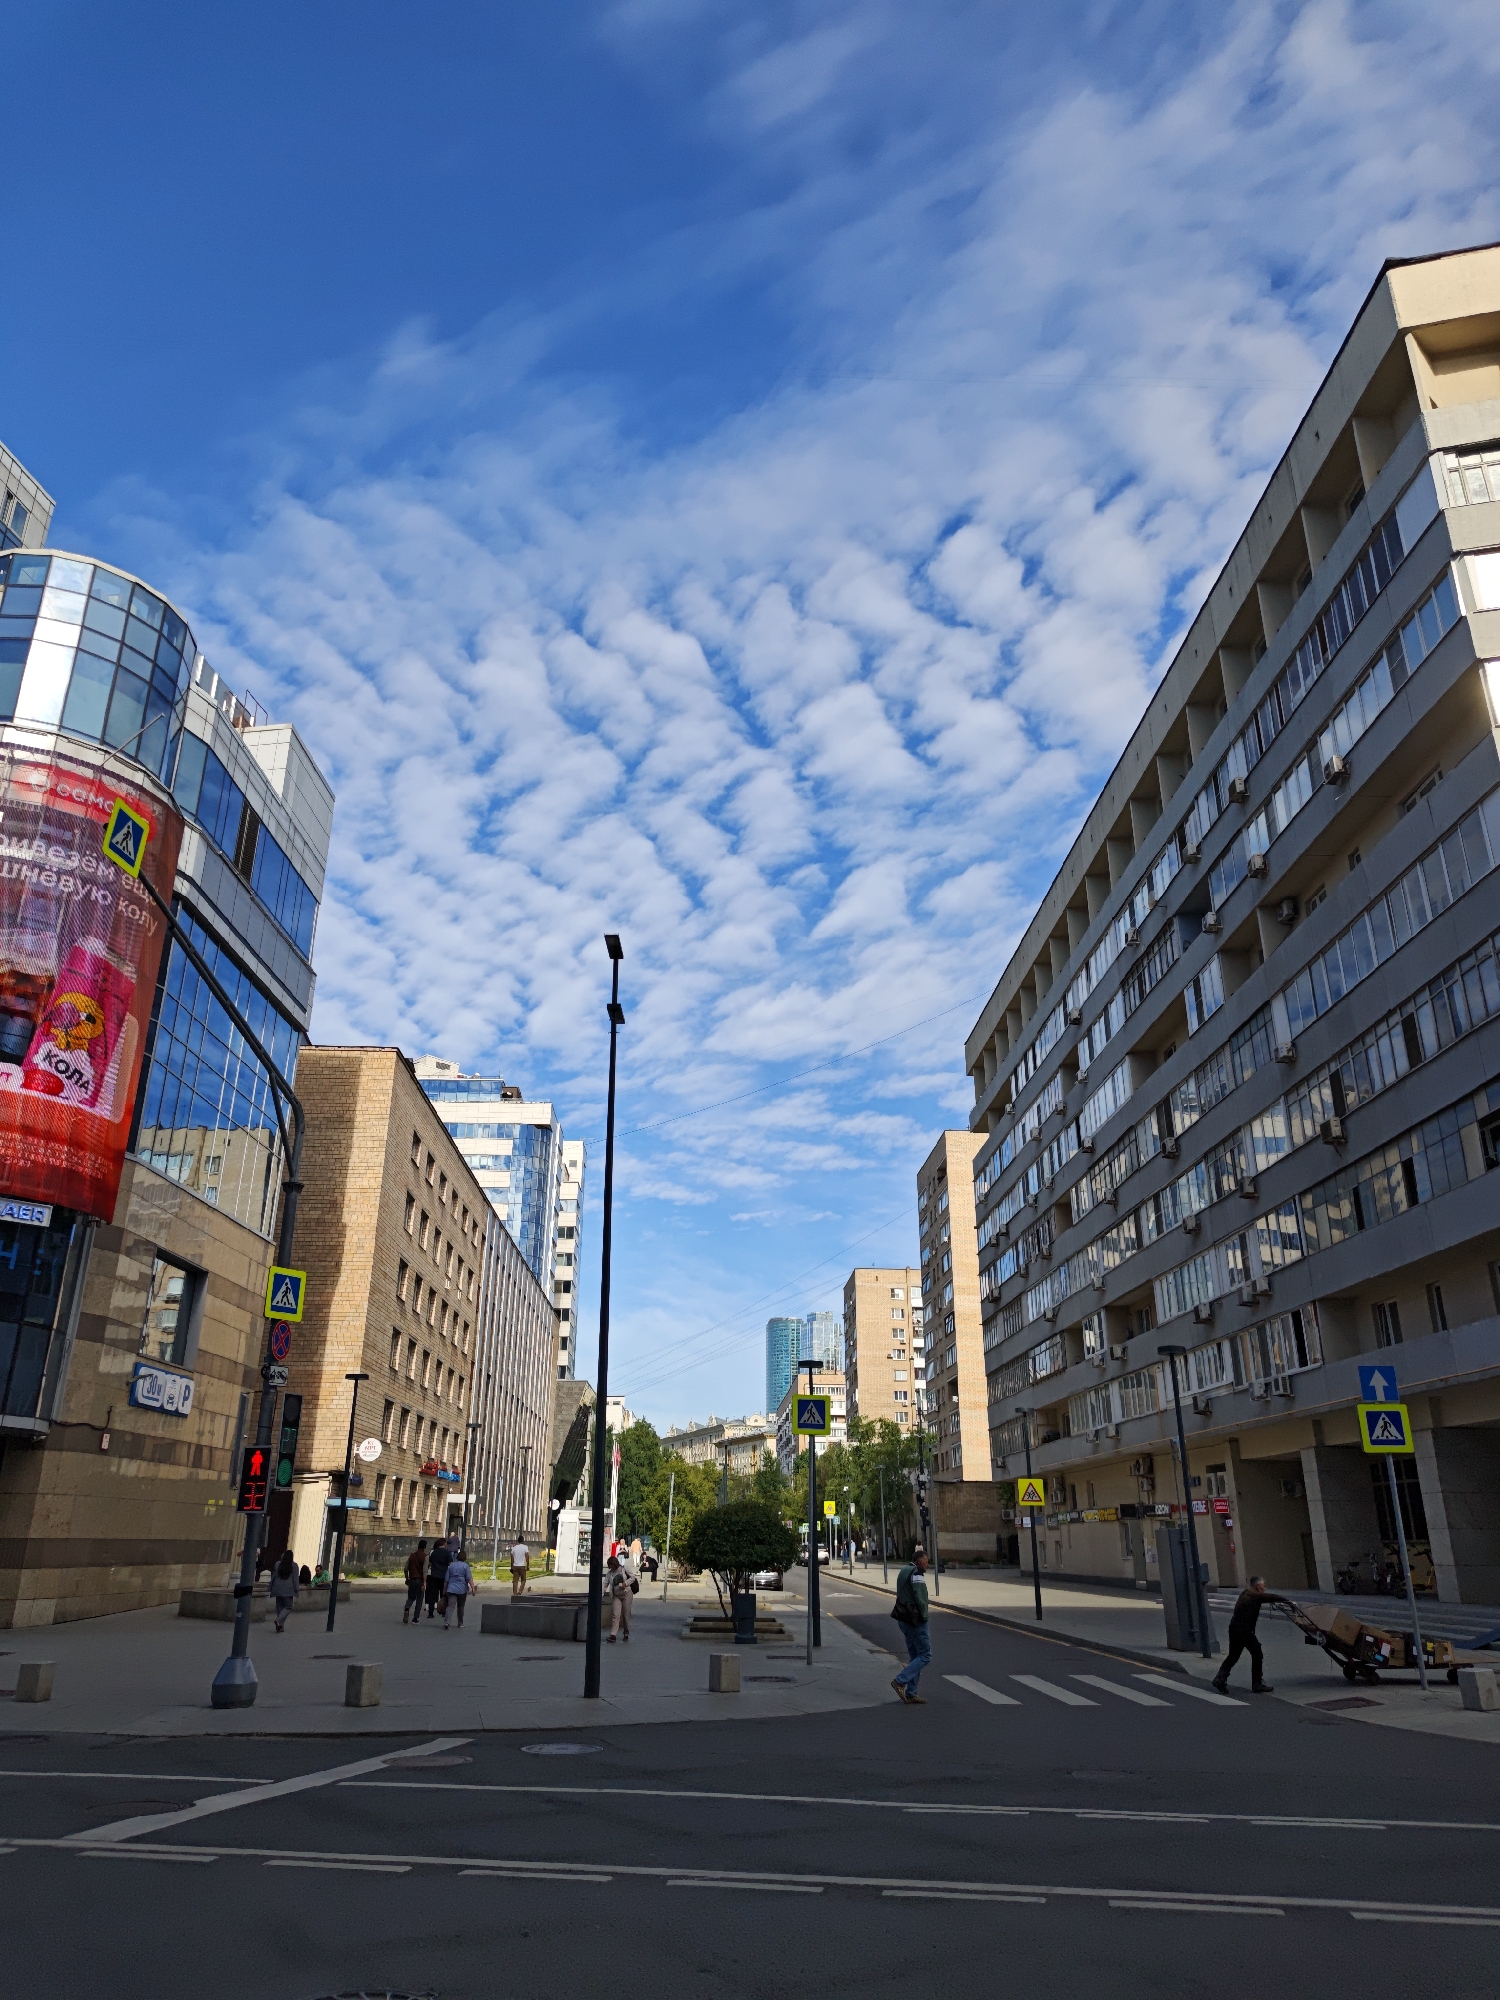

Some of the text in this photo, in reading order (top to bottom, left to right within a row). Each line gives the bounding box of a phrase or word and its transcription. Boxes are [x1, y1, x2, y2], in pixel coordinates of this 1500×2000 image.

[57, 783, 115, 813] само
[119, 896, 158, 936] колу
[43, 1049, 90, 1095] КОЛА
[0, 1202, 46, 1222] AER
